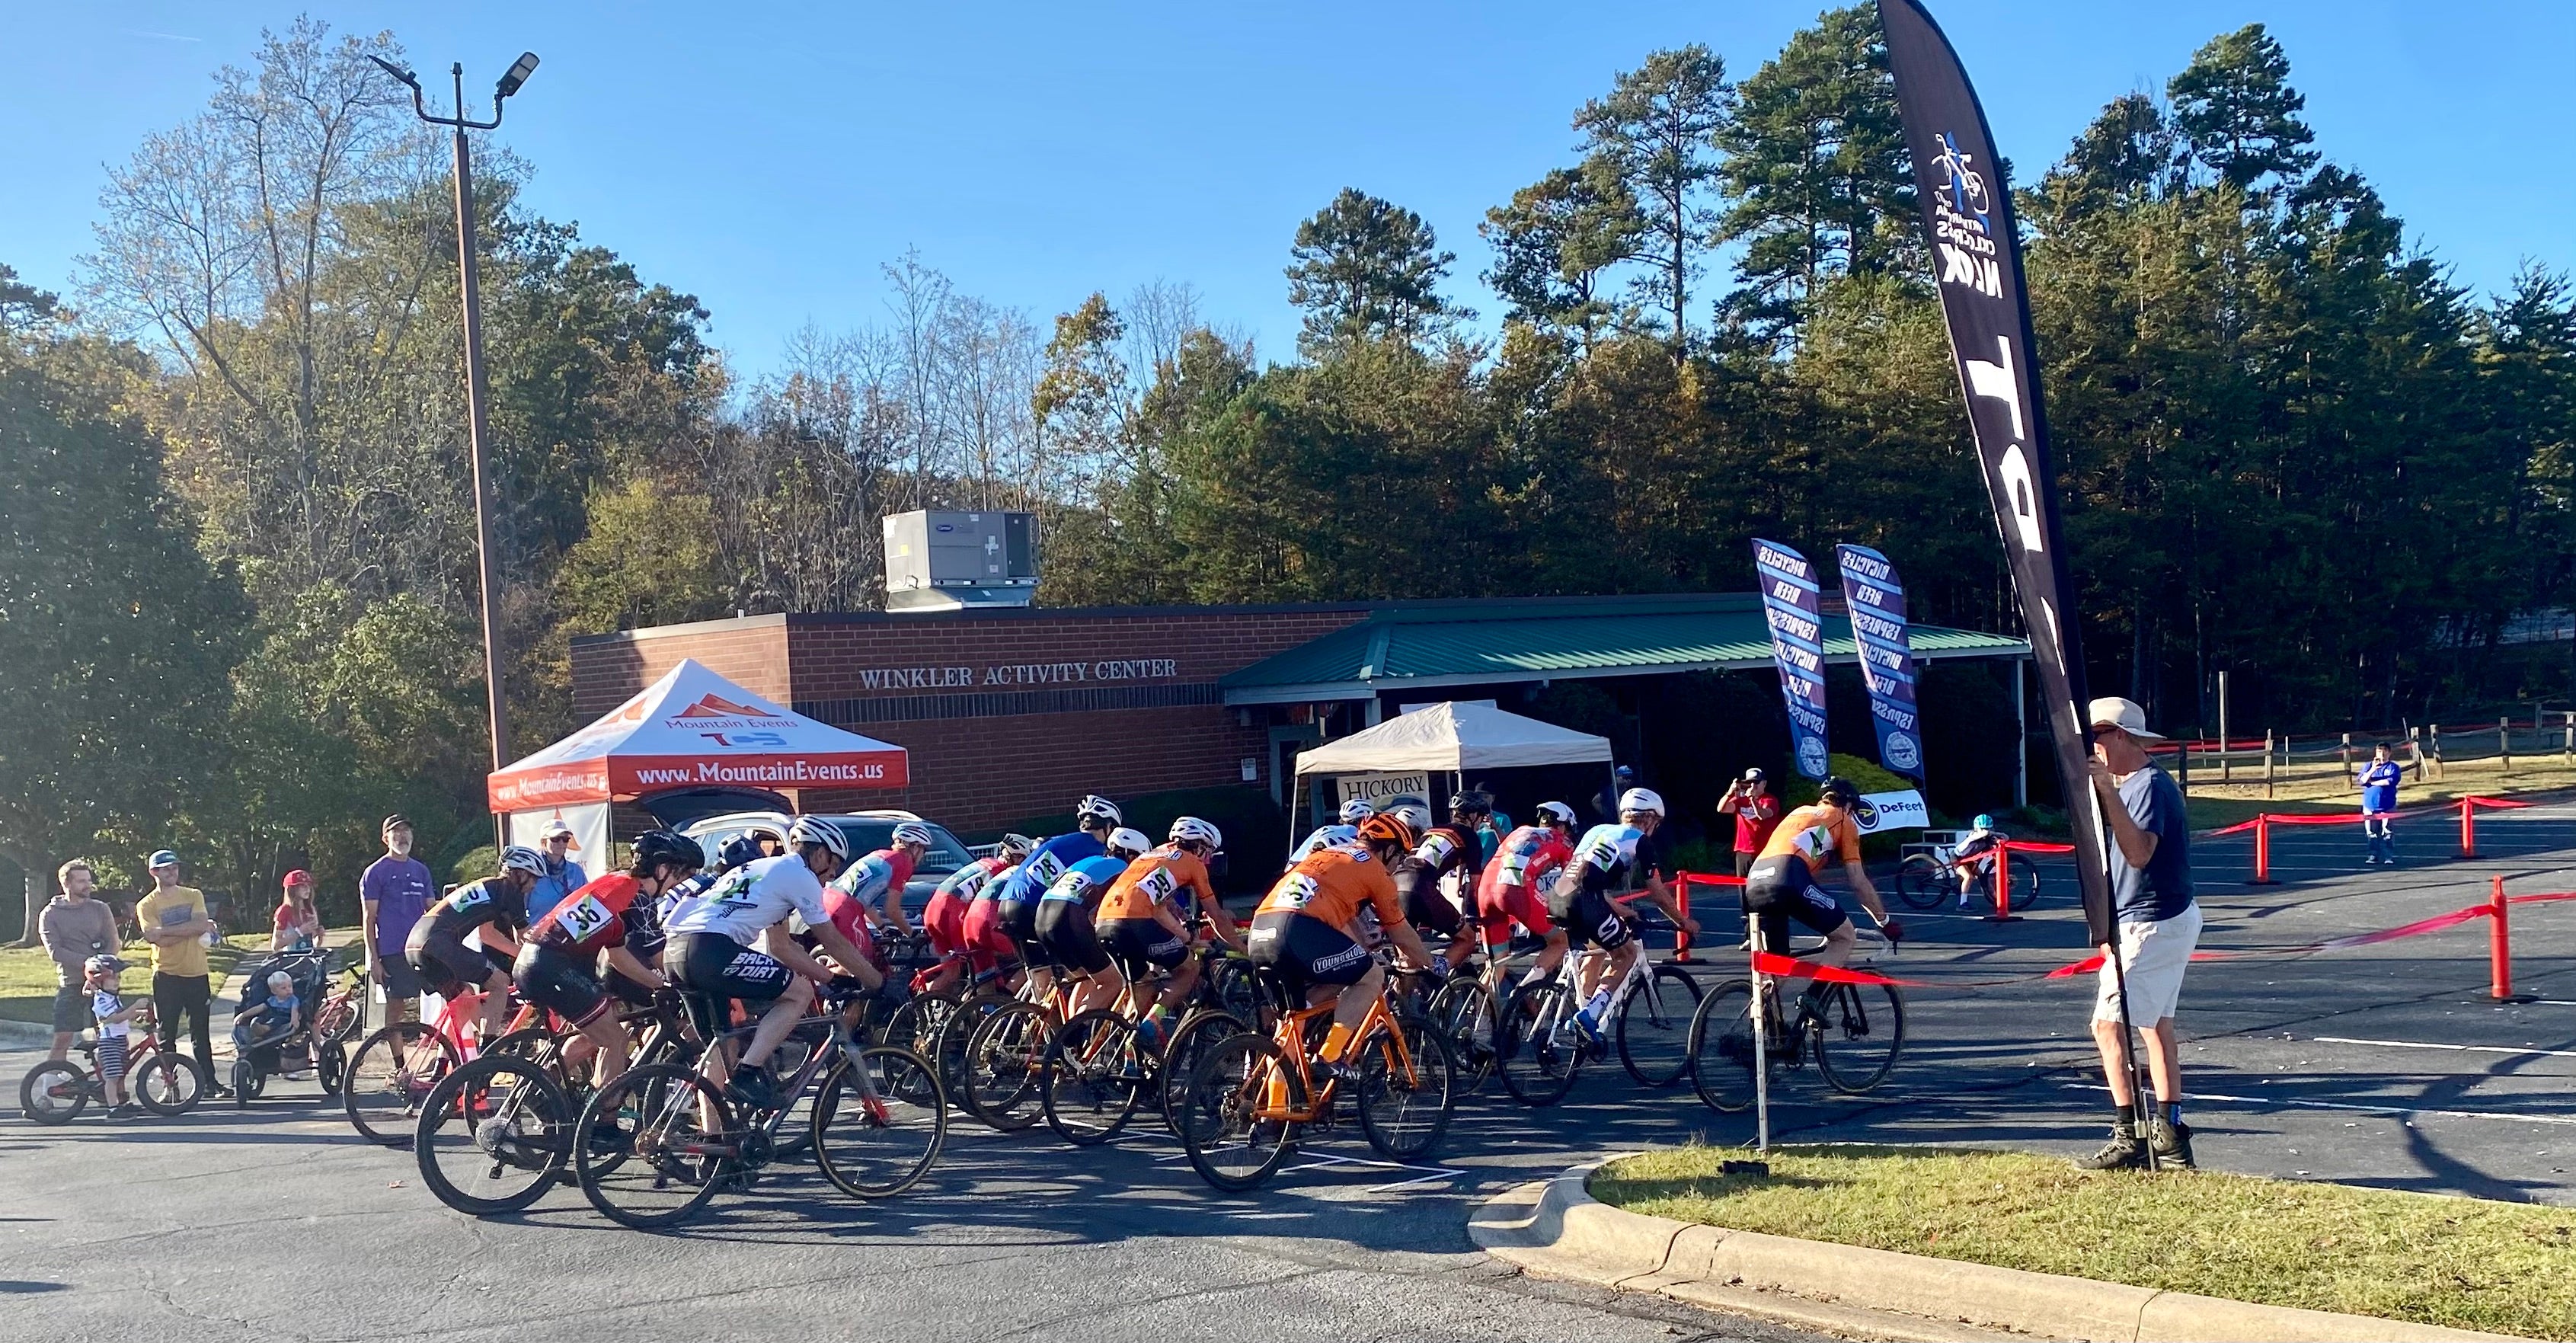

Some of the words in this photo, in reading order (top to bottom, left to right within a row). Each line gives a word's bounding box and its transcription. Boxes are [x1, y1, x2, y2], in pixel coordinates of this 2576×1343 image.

[859, 667, 973, 689] WINKLER
[983, 661, 1088, 686] ACTIVITY
[1095, 658, 1178, 679] CENTER
[665, 719, 743, 729] Mountain
[746, 718, 798, 727] Events
[637, 762, 884, 783] www.MountainEvents.us
[497, 772, 597, 801] www.MountainEvents.us
[1344, 775, 1424, 800] HICKORY
[1879, 801, 1924, 813] DeFeet
[1034, 859, 1058, 880] 28
[722, 877, 750, 900] 24
[1147, 873, 1171, 899] 39
[567, 903, 601, 931] 36
[731, 952, 774, 966] BACK
[737, 965, 779, 979] DIRT
